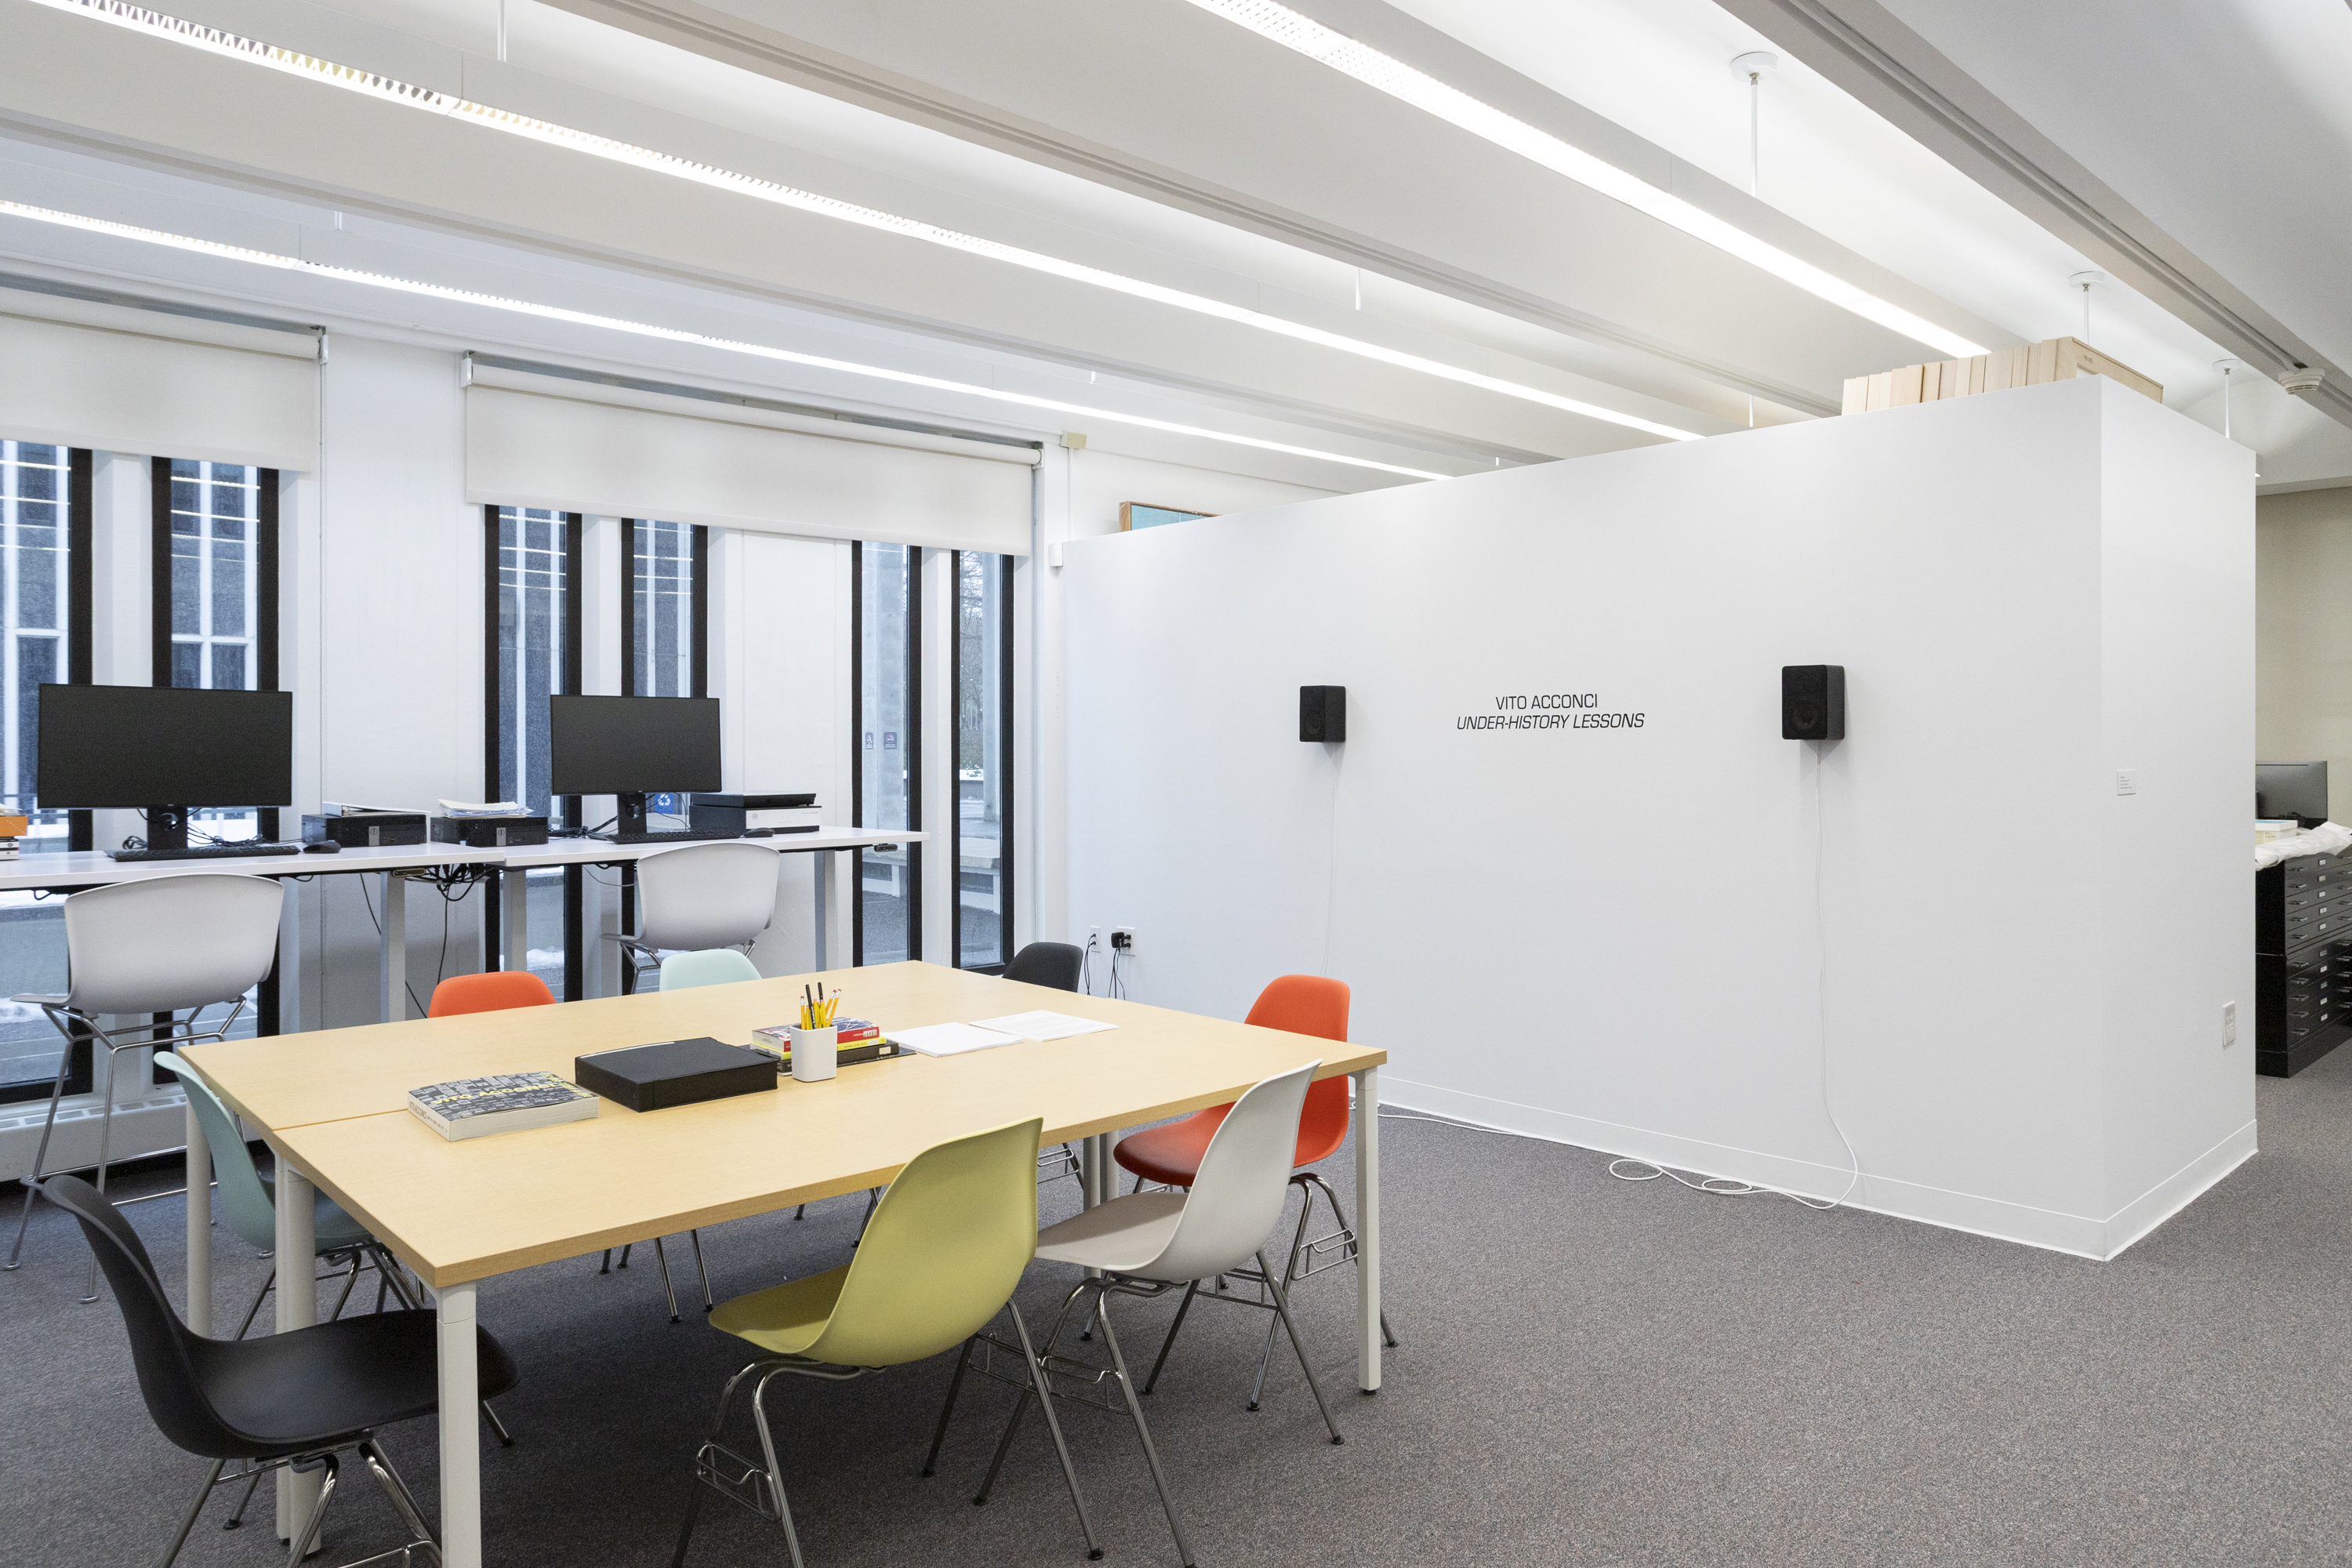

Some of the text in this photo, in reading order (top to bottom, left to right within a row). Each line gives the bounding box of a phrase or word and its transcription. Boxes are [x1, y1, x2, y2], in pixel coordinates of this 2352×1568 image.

[1495, 693, 1598, 710] VITO ACCONCI
[1457, 713, 1645, 730] UNDER-HISTORY LESSONS
[430, 1094, 472, 1105] VITO
[479, 1083, 556, 1097] ACCONCI
